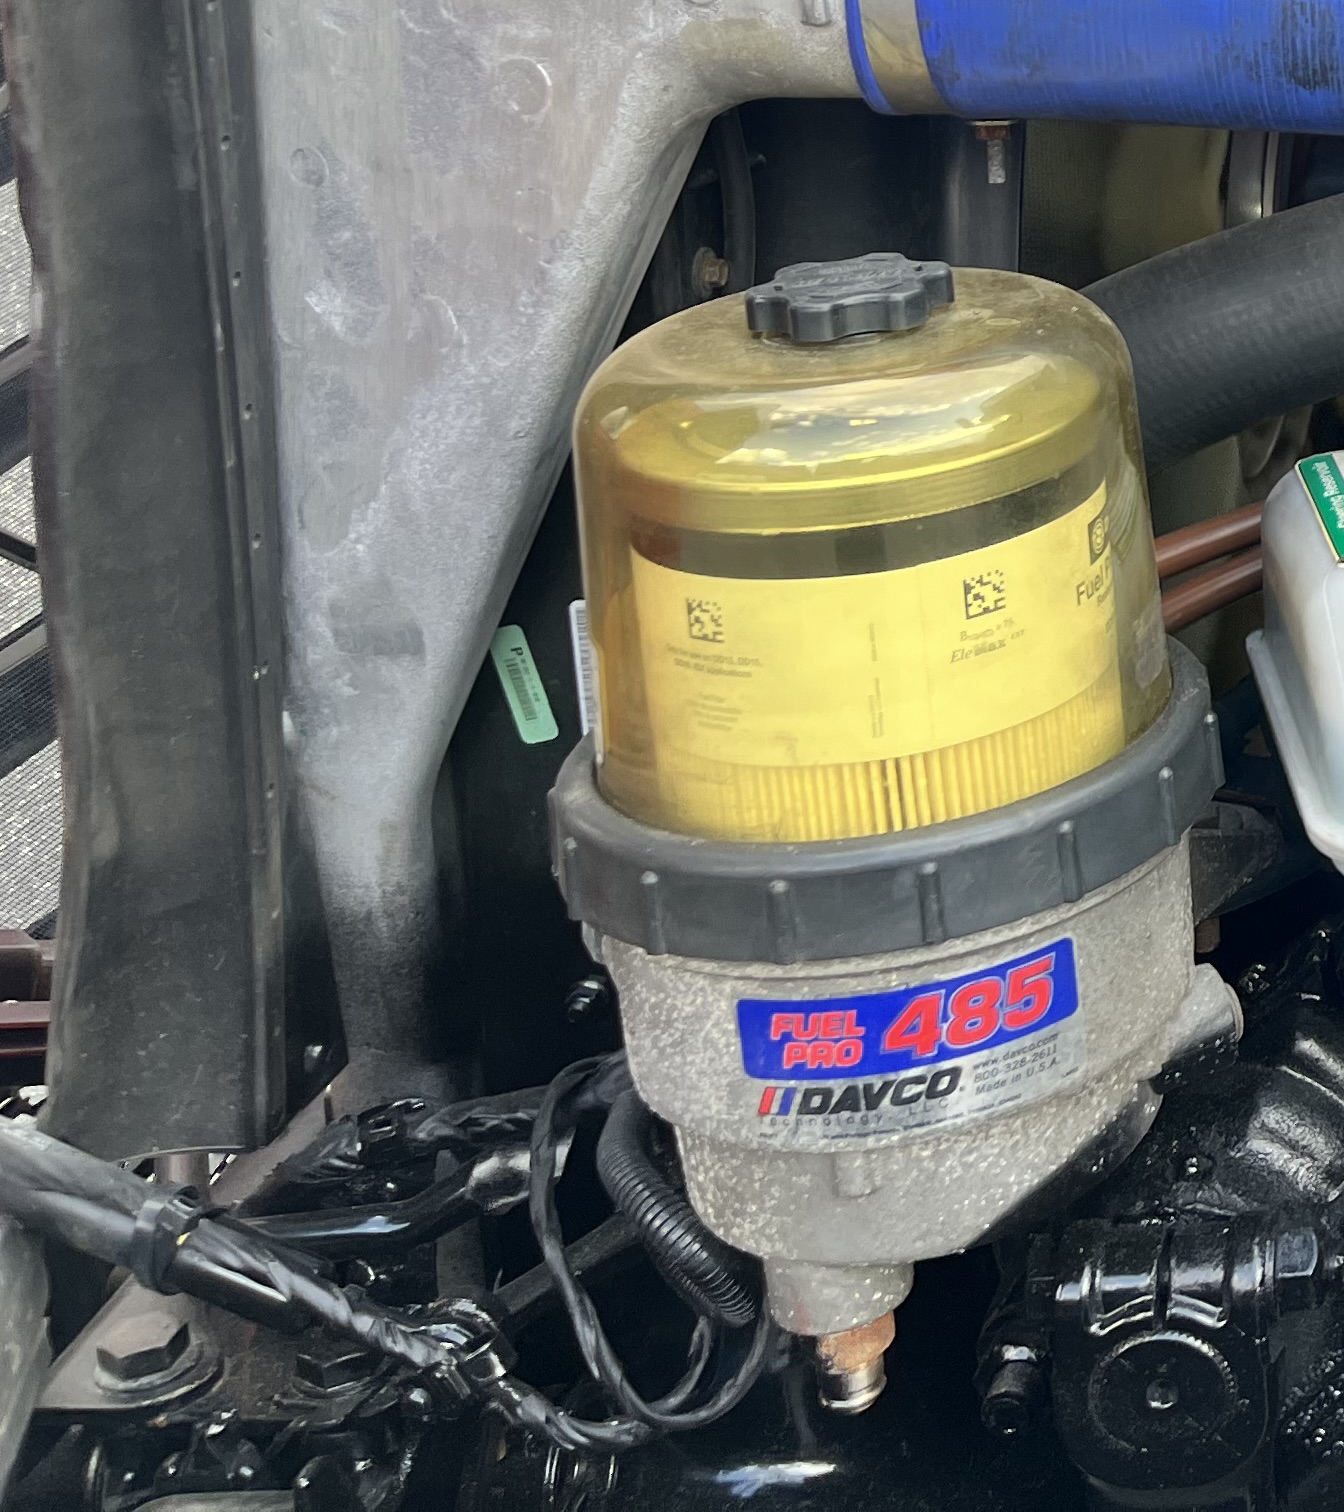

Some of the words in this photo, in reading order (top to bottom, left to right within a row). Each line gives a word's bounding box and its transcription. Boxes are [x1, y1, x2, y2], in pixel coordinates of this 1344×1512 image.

[1313, 461, 1341, 498] Reservoir
[880, 951, 1057, 1058] 485
[770, 1009, 865, 1040] FUEL
[783, 1039, 863, 1069] PRO
[973, 1032, 1060, 1070] www.davco.com
[973, 1044, 1058, 1084] 800-328-2611
[797, 1066, 962, 1115] DAVCO
[975, 1079, 1007, 1096] Made
[1011, 1071, 1022, 1084] in
